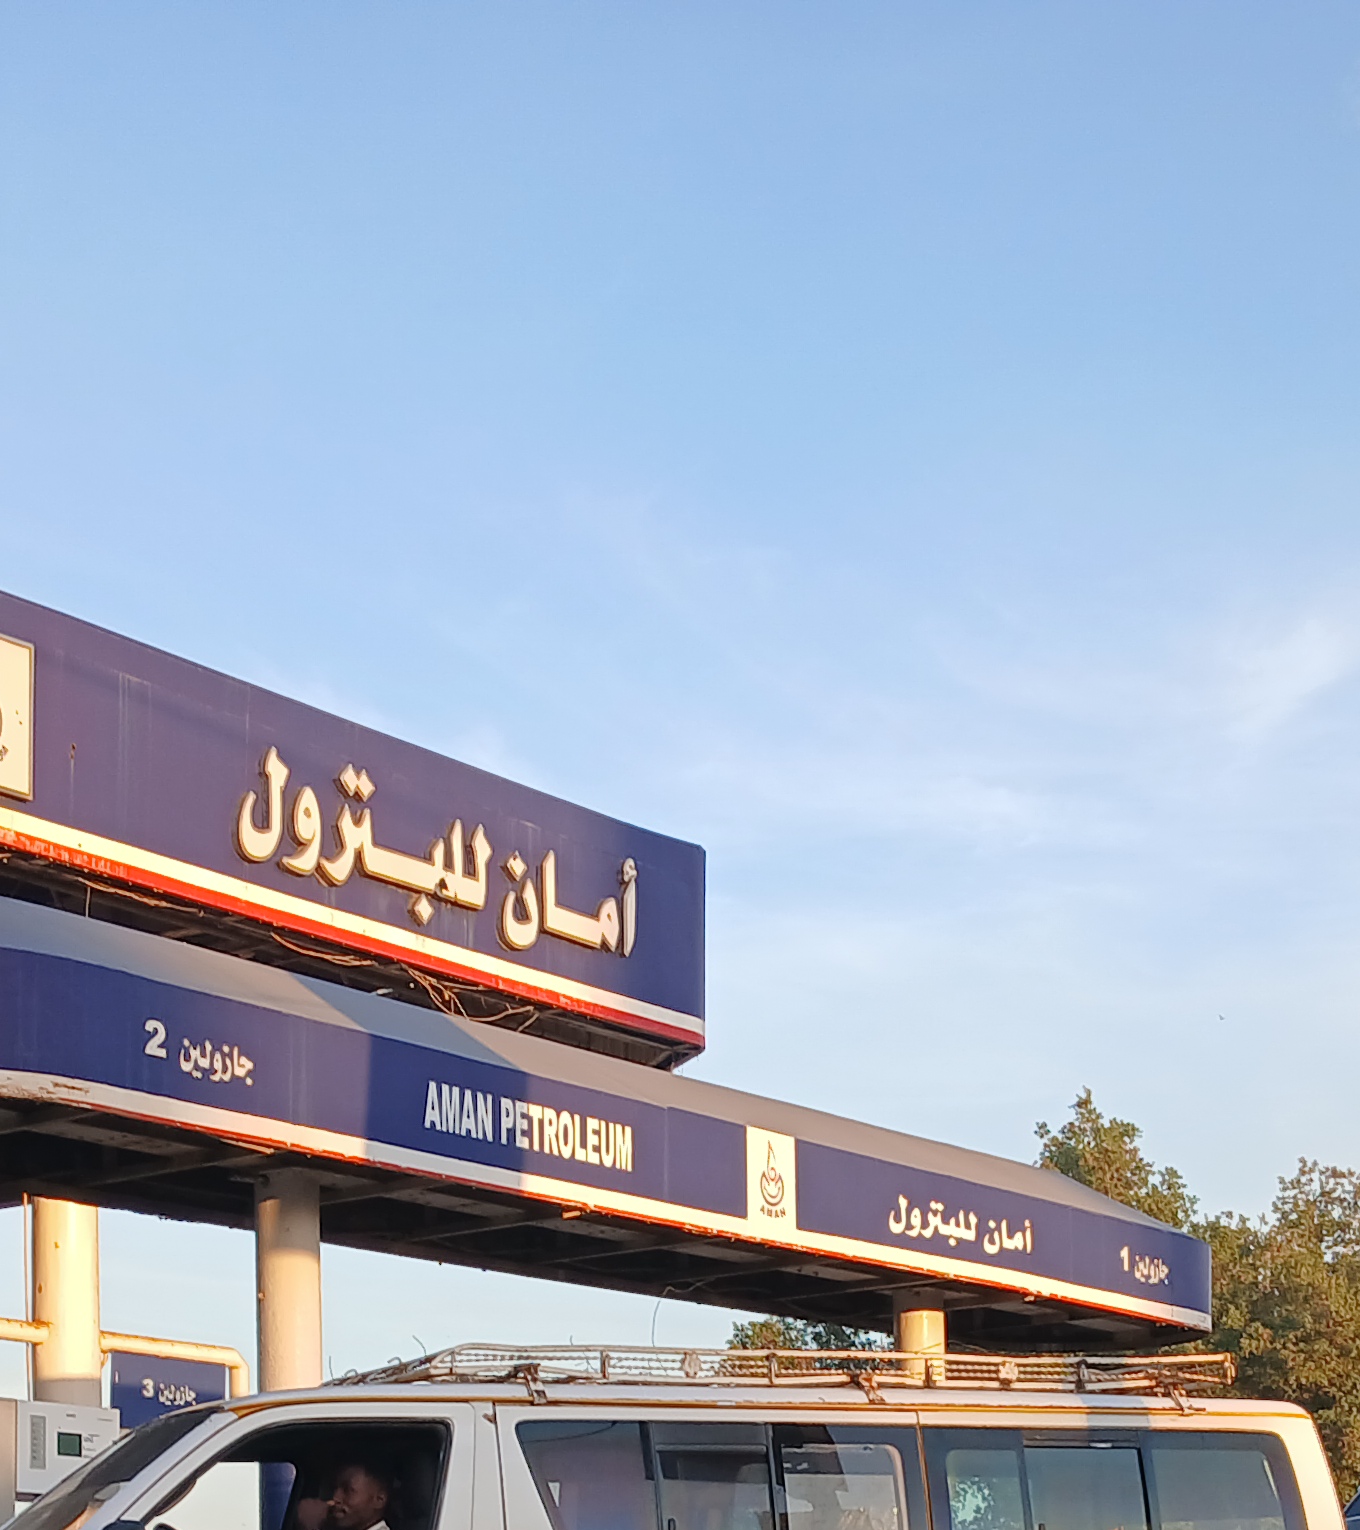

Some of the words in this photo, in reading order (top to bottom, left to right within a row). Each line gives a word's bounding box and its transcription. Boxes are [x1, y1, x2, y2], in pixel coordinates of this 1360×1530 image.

[232, 745, 495, 926] للبترول
[496, 849, 639, 959] أمان
[143, 1019, 168, 1059] 2
[177, 1036, 255, 1086] جازولين
[423, 1080, 494, 1143] AMAN
[499, 1096, 633, 1173] PETROLEUM
[888, 1193, 979, 1247] للبترول
[982, 1218, 1033, 1255] أمان
[1119, 1246, 1131, 1272] 1
[1133, 1252, 1170, 1286] جازولين
[141, 1378, 155, 1399] 3
[158, 1381, 197, 1406] جازولين
